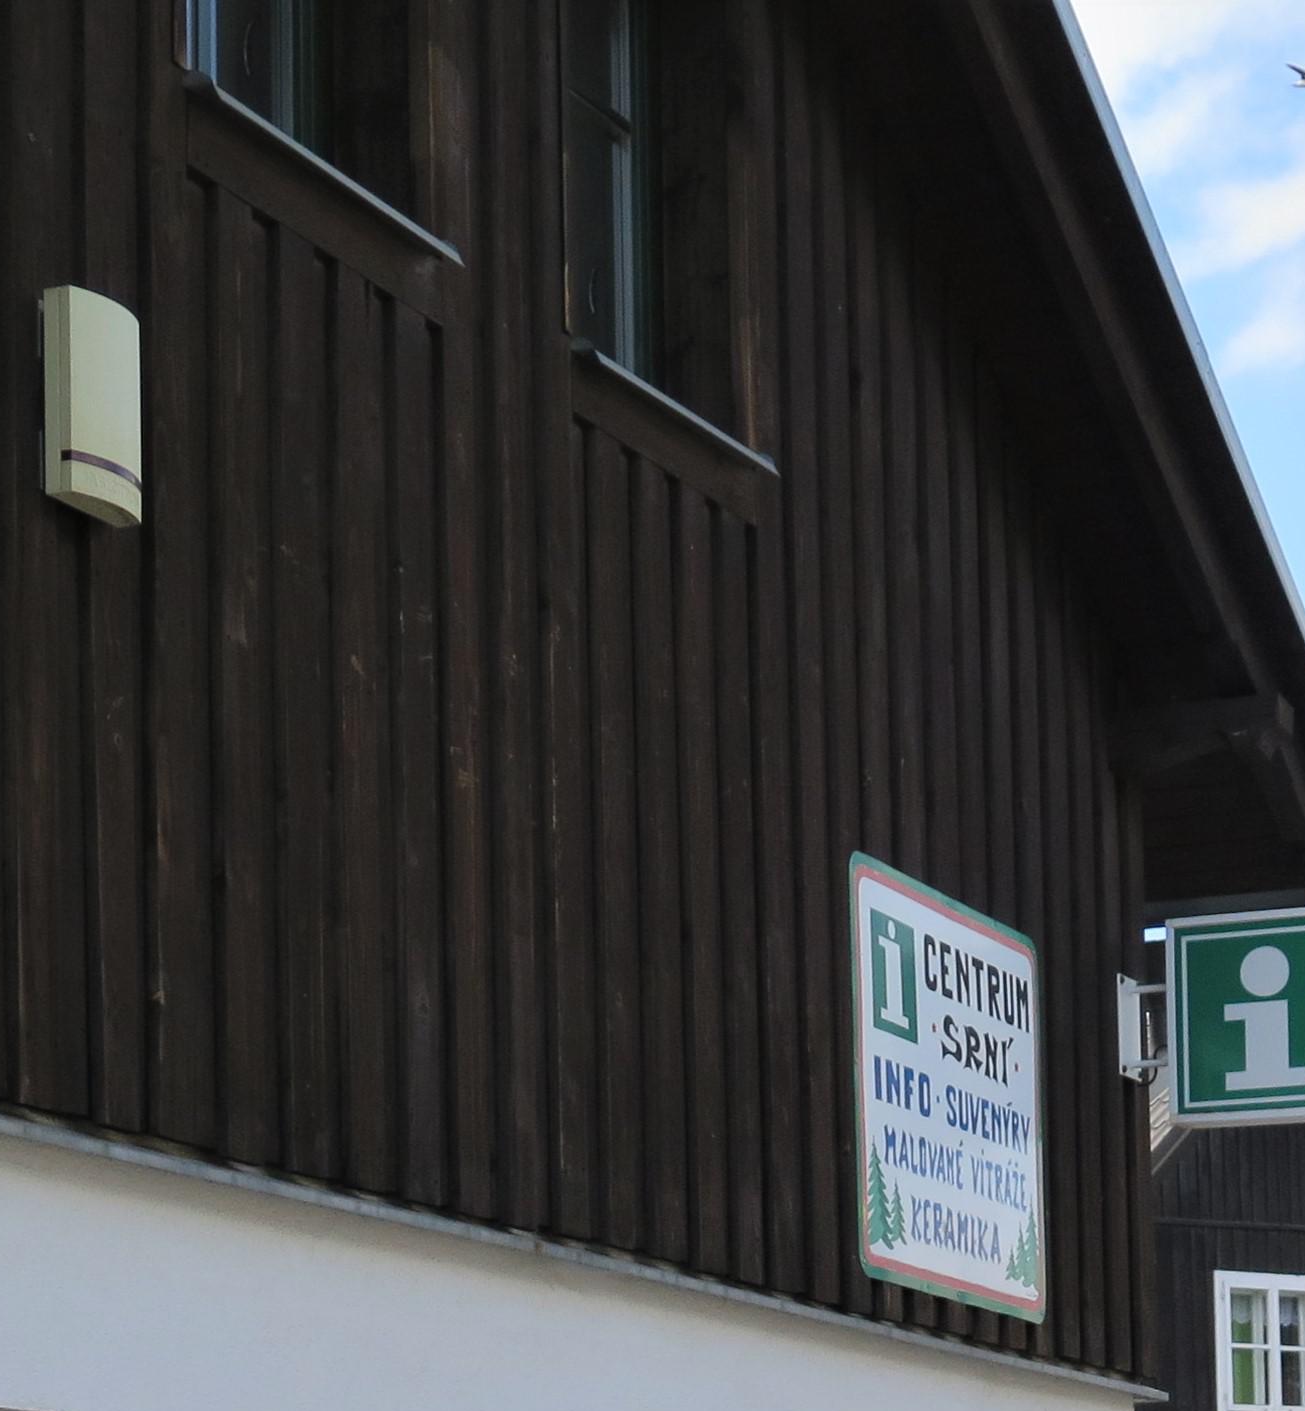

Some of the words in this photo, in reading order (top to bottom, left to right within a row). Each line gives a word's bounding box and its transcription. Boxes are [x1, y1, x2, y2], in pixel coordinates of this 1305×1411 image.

[923, 933, 1030, 1034] CENTRUM
[940, 1014, 1014, 1088] SRNÍ
[873, 1054, 931, 1118] INFO
[946, 1084, 1031, 1155] SUVENÝRY
[883, 1124, 964, 1190] MALOVANÉ
[910, 1194, 1001, 1264] KERAMIKA
